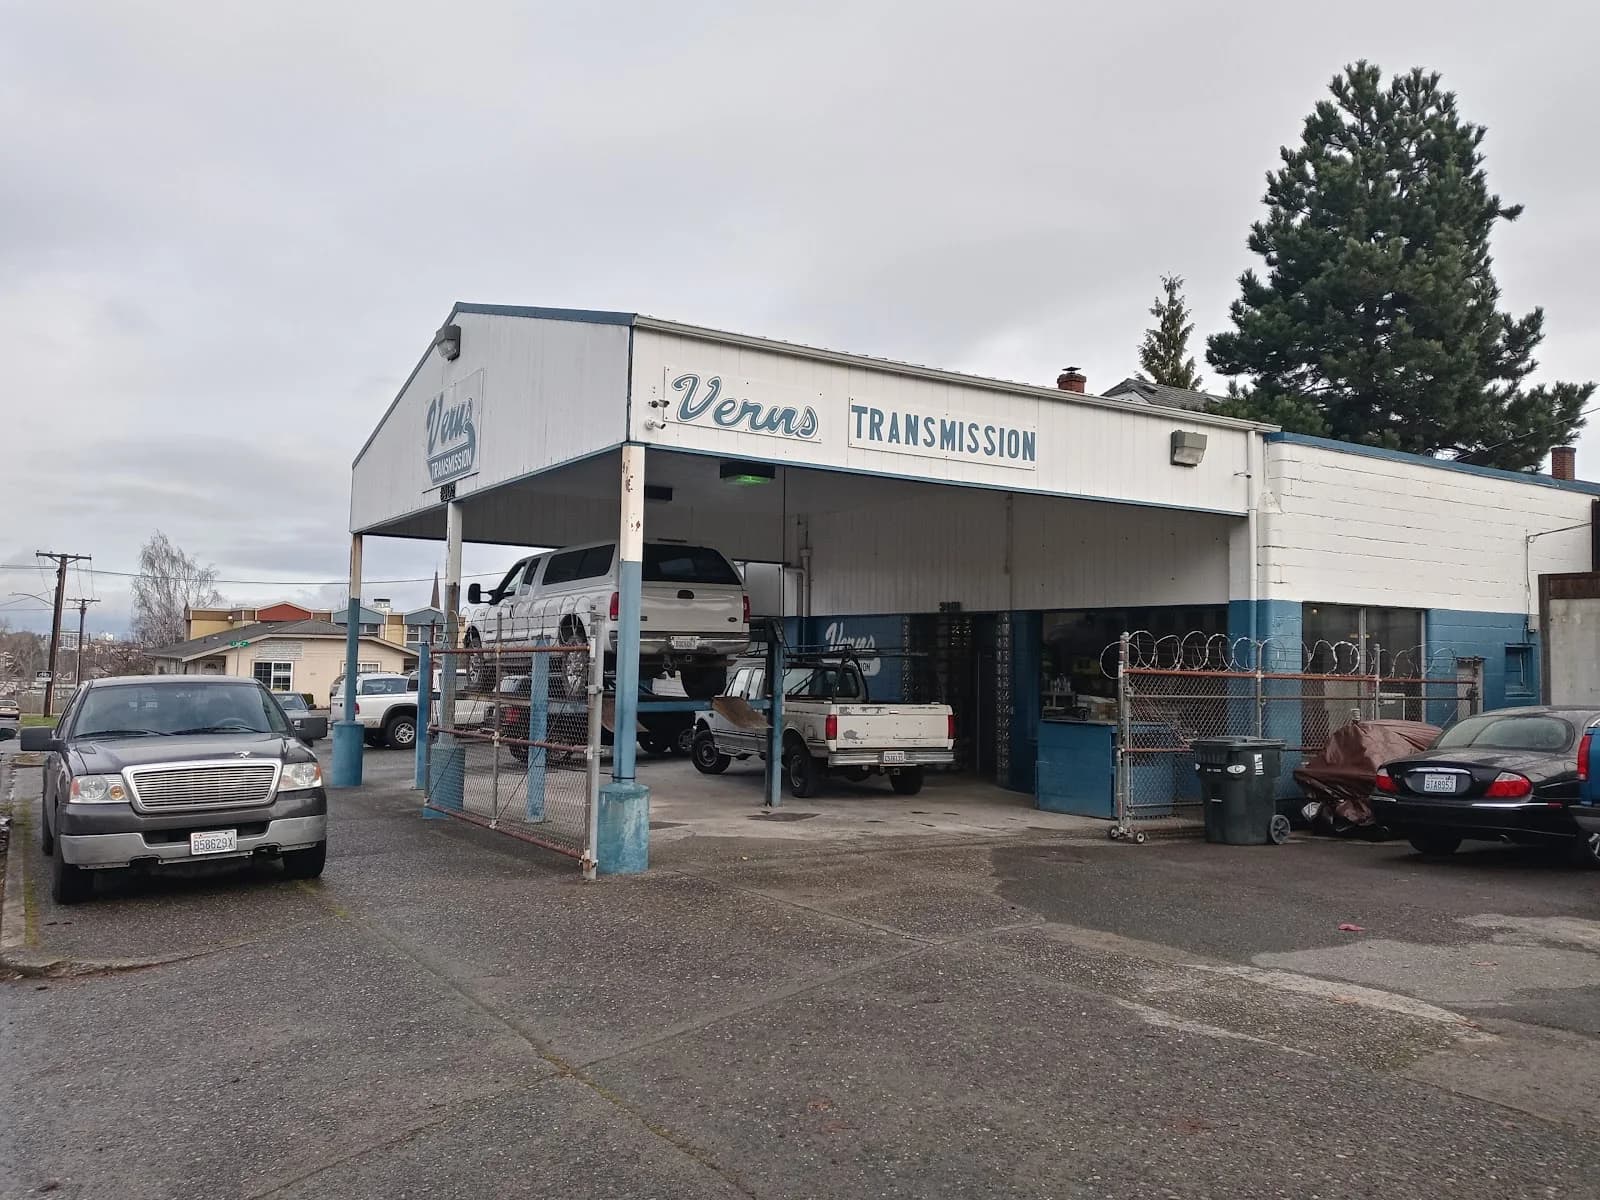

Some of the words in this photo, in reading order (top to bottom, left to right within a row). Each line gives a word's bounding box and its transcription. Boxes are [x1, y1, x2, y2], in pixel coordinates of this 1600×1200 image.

[426, 391, 473, 455] Verns
[671, 373, 820, 439] Verns
[851, 404, 1037, 462] TRANSMISSION
[431, 447, 472, 480] TRANSMISSION
[193, 837, 233, 851] B58629X
